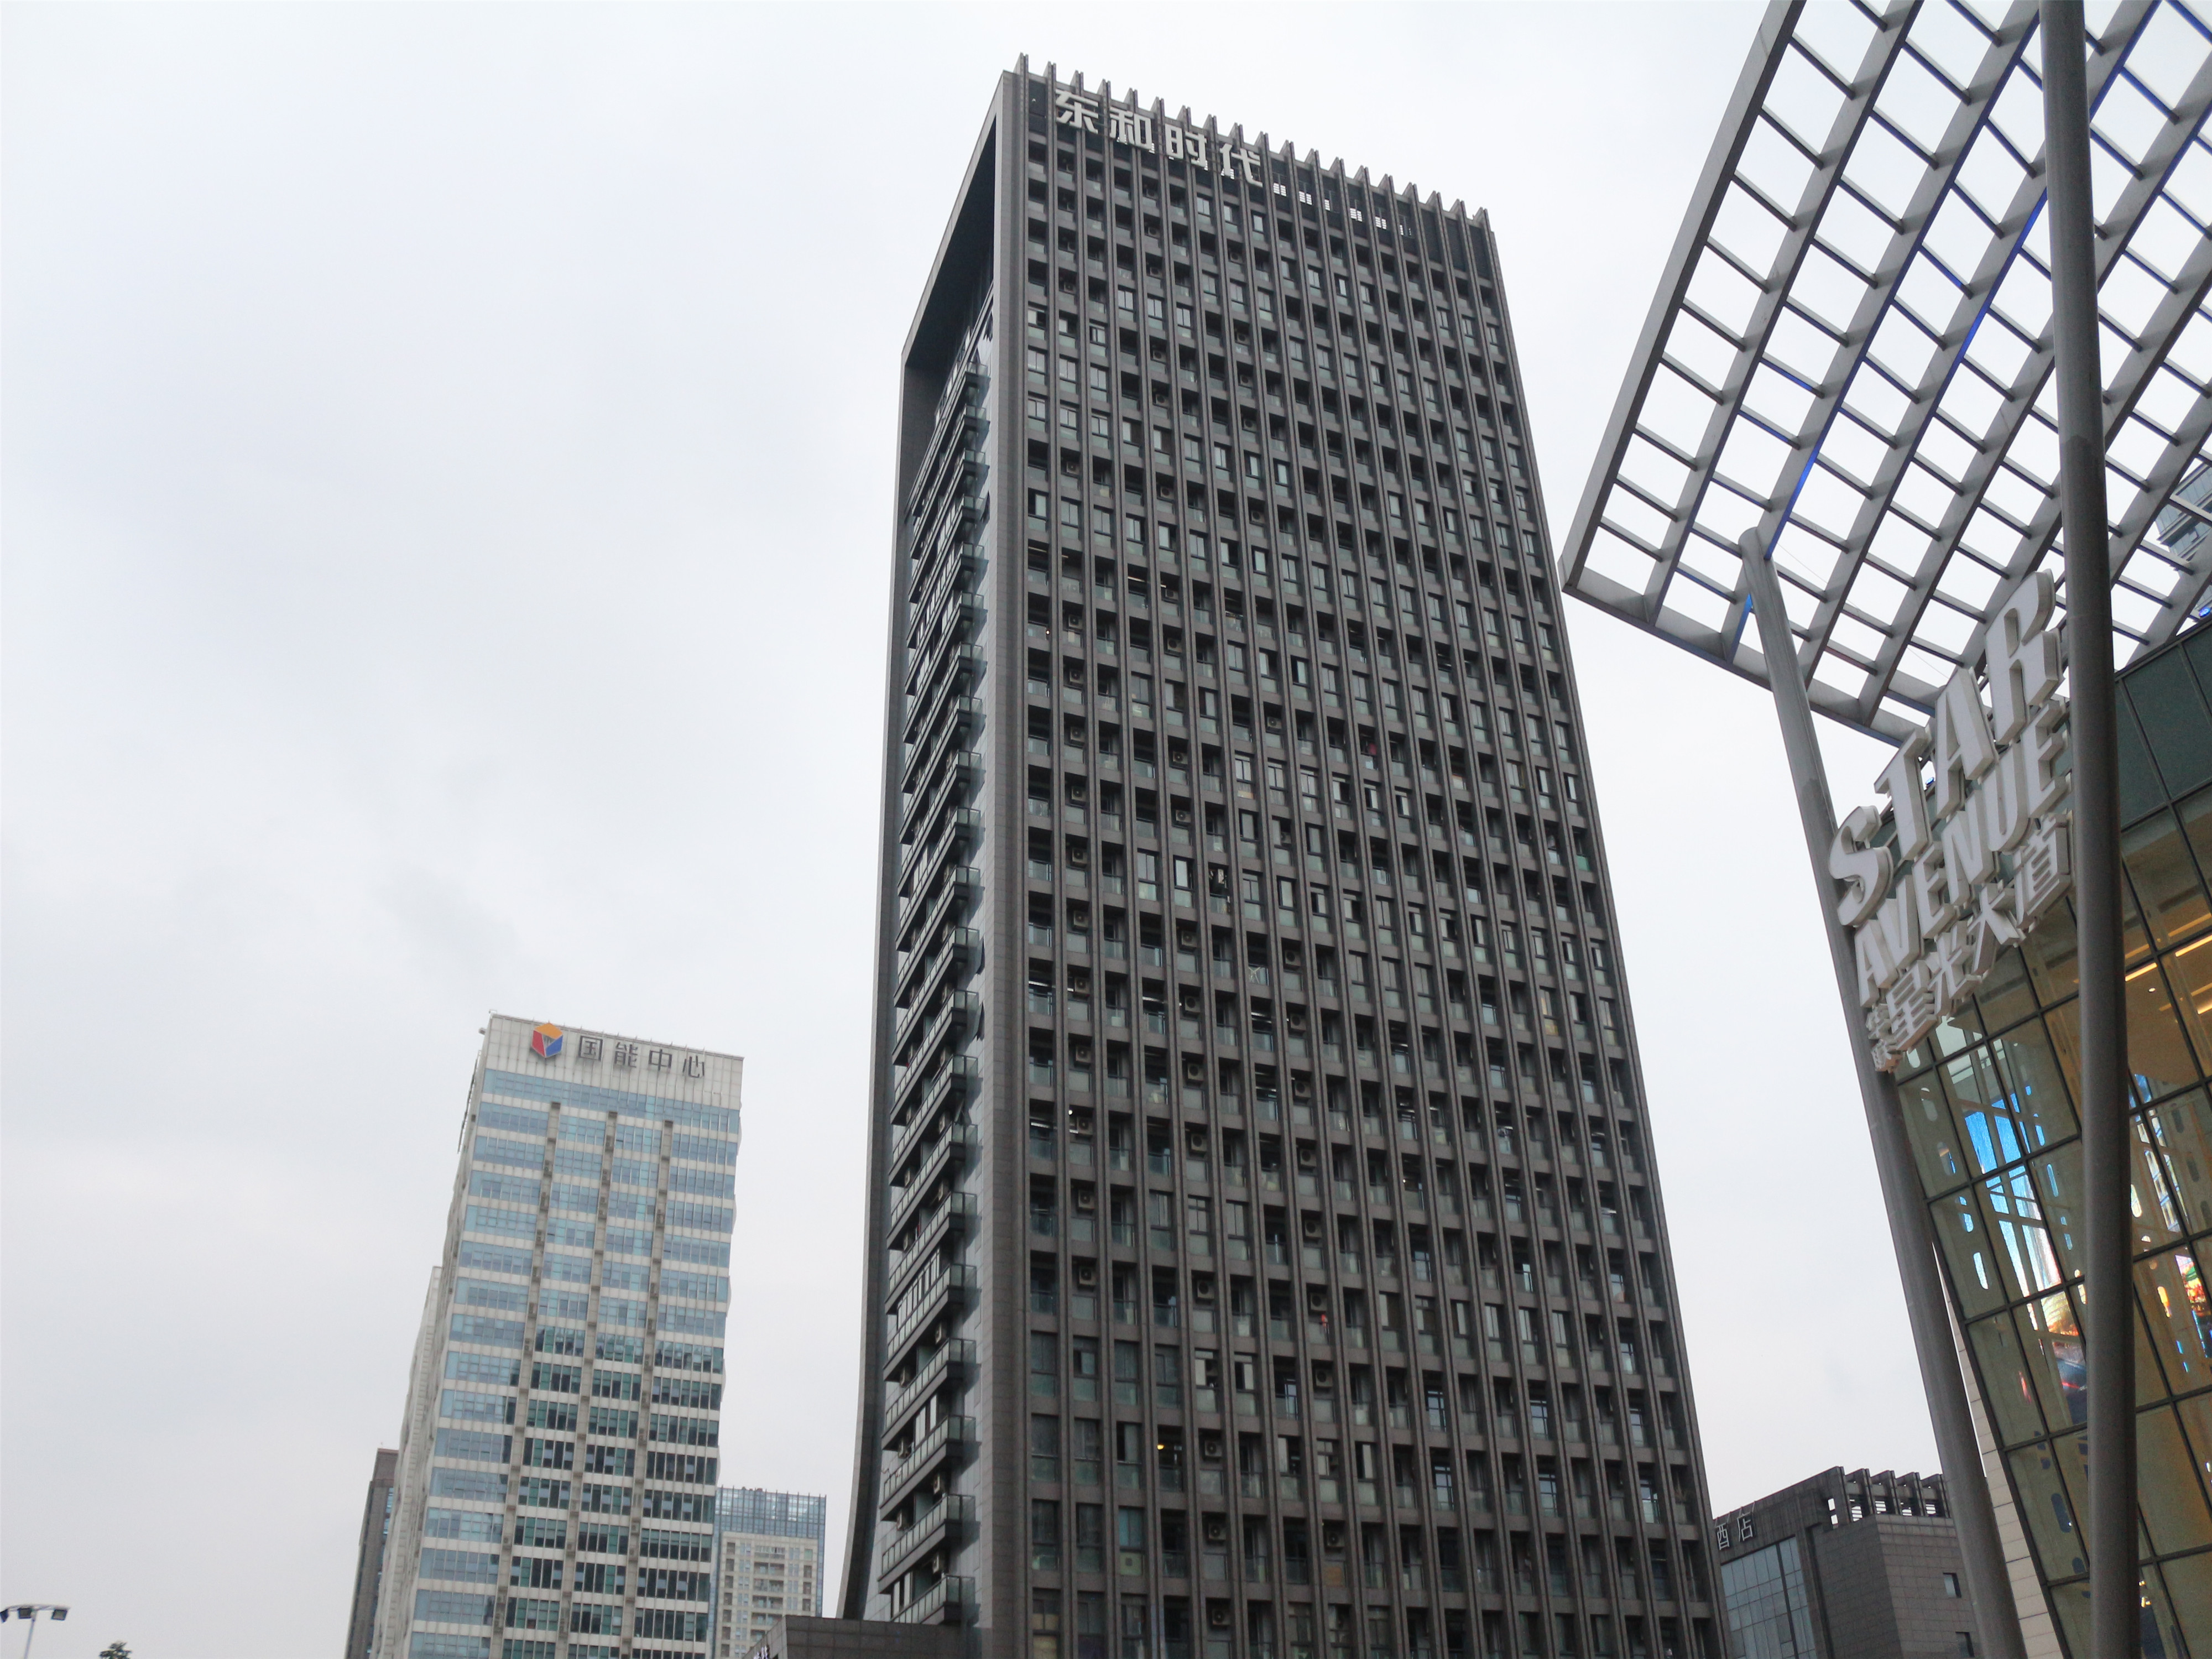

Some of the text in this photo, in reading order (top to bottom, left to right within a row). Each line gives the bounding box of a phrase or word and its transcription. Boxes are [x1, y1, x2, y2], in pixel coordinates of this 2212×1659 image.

[1055, 88, 1263, 187] 东和时代
[1828, 568, 2064, 927] STAR
[1854, 698, 2070, 1008] AVENUE
[1886, 810, 2073, 1052] 星光大道
[578, 1035, 705, 1078] 国能中心
